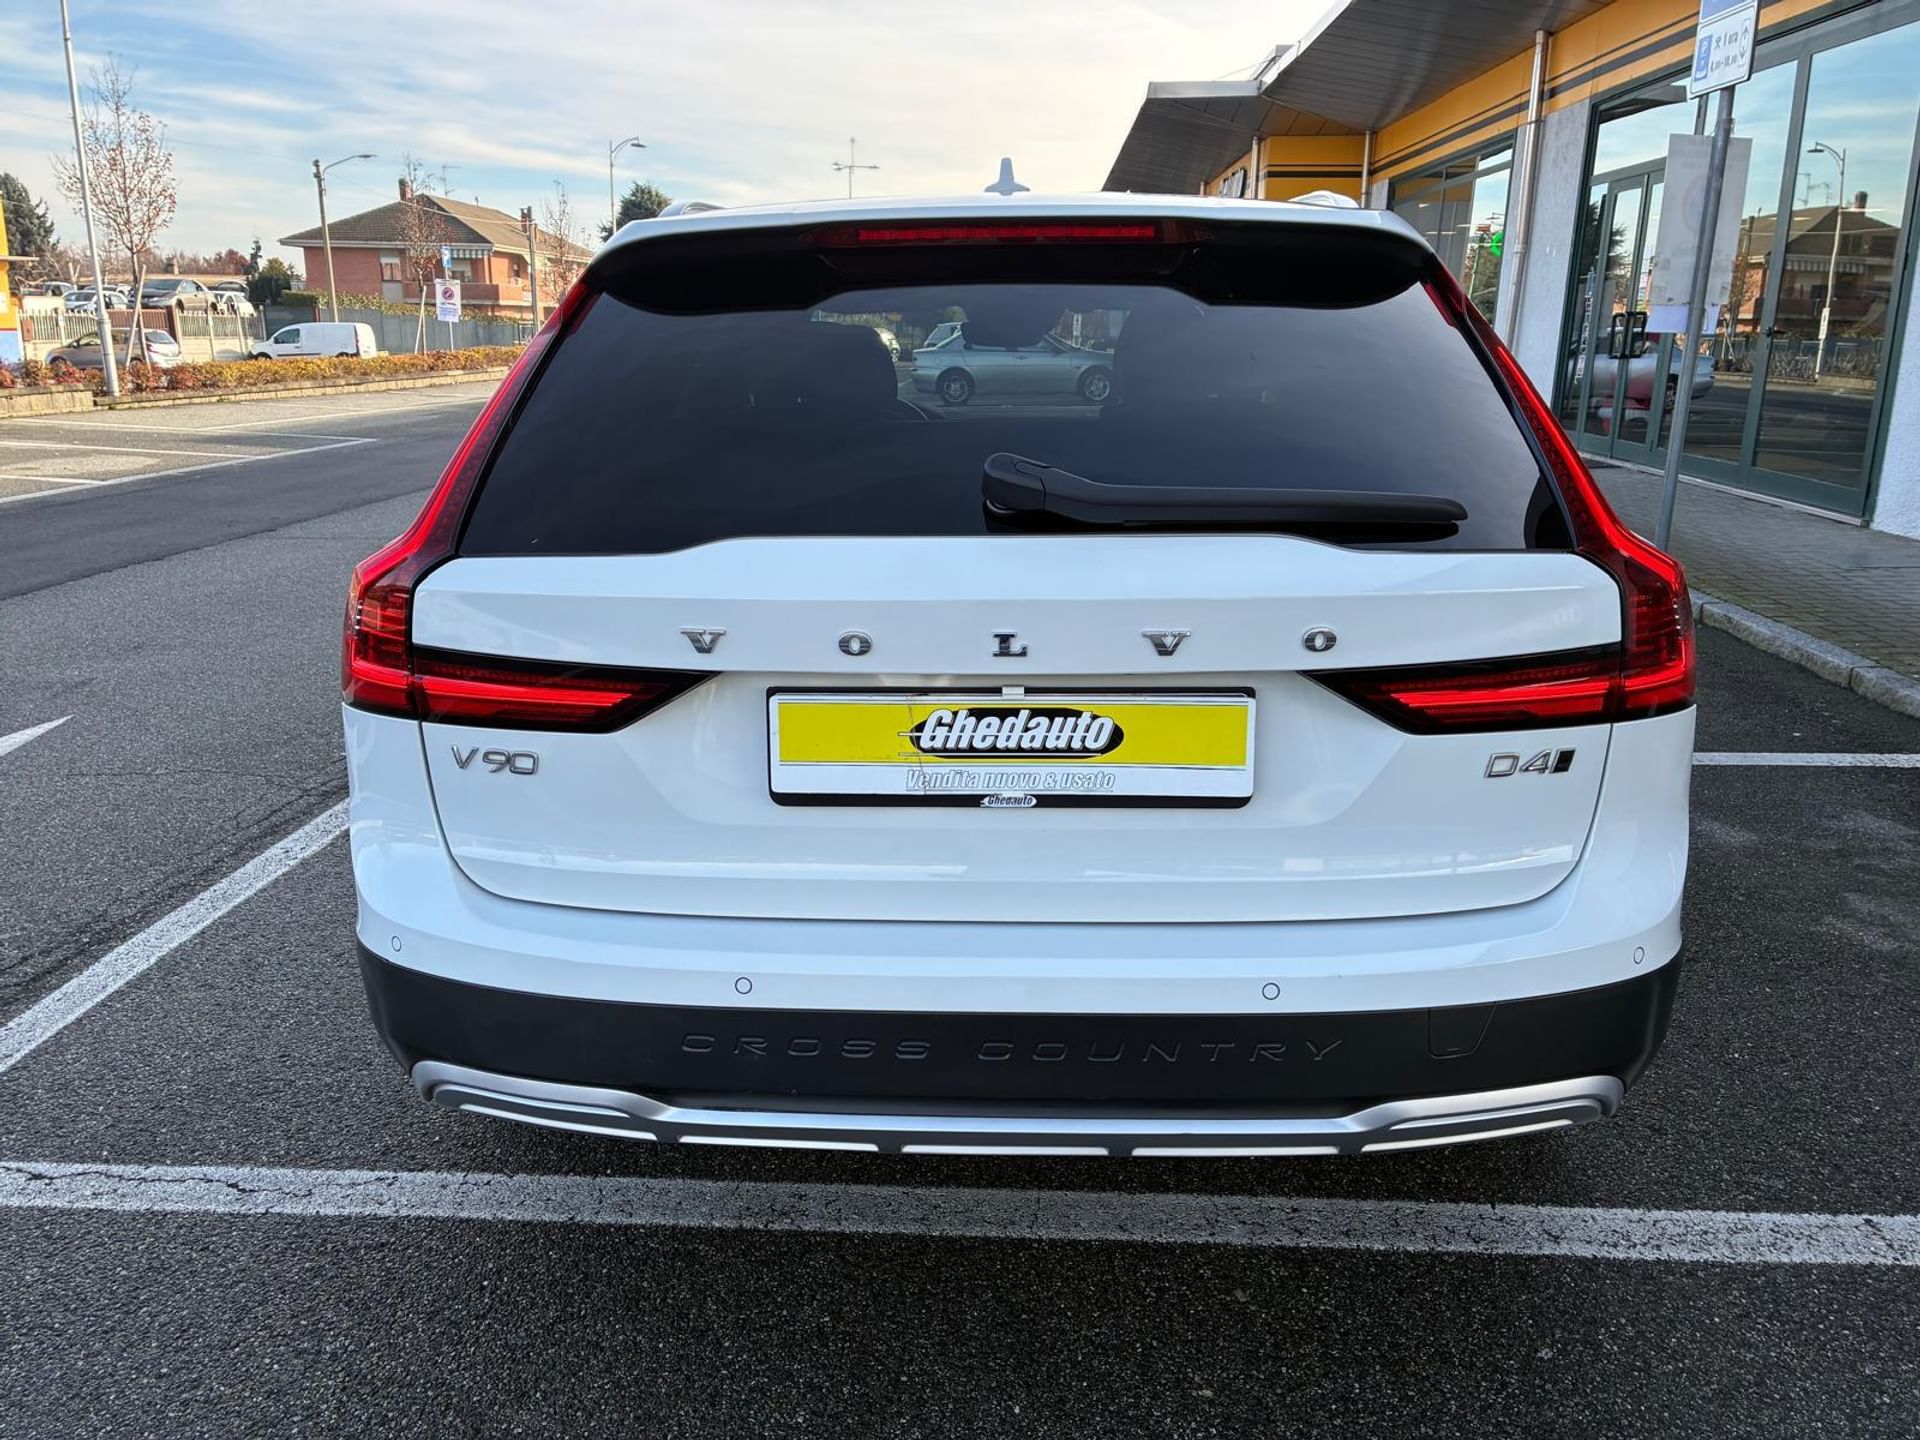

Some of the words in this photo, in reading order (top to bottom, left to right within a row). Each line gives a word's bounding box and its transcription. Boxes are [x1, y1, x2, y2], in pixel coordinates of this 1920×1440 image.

[680, 626, 1337, 658] VOLVO
[919, 708, 1115, 750] Ghedauto
[451, 744, 539, 775] V90
[1484, 748, 1551, 778] D4
[906, 769, 980, 789] Vendita
[984, 771, 1040, 789] nuovo
[1043, 772, 1057, 789] &
[1059, 771, 1115, 790] usato
[681, 1035, 931, 1060] CROSS
[977, 1040, 1343, 1062] COUNTRY
